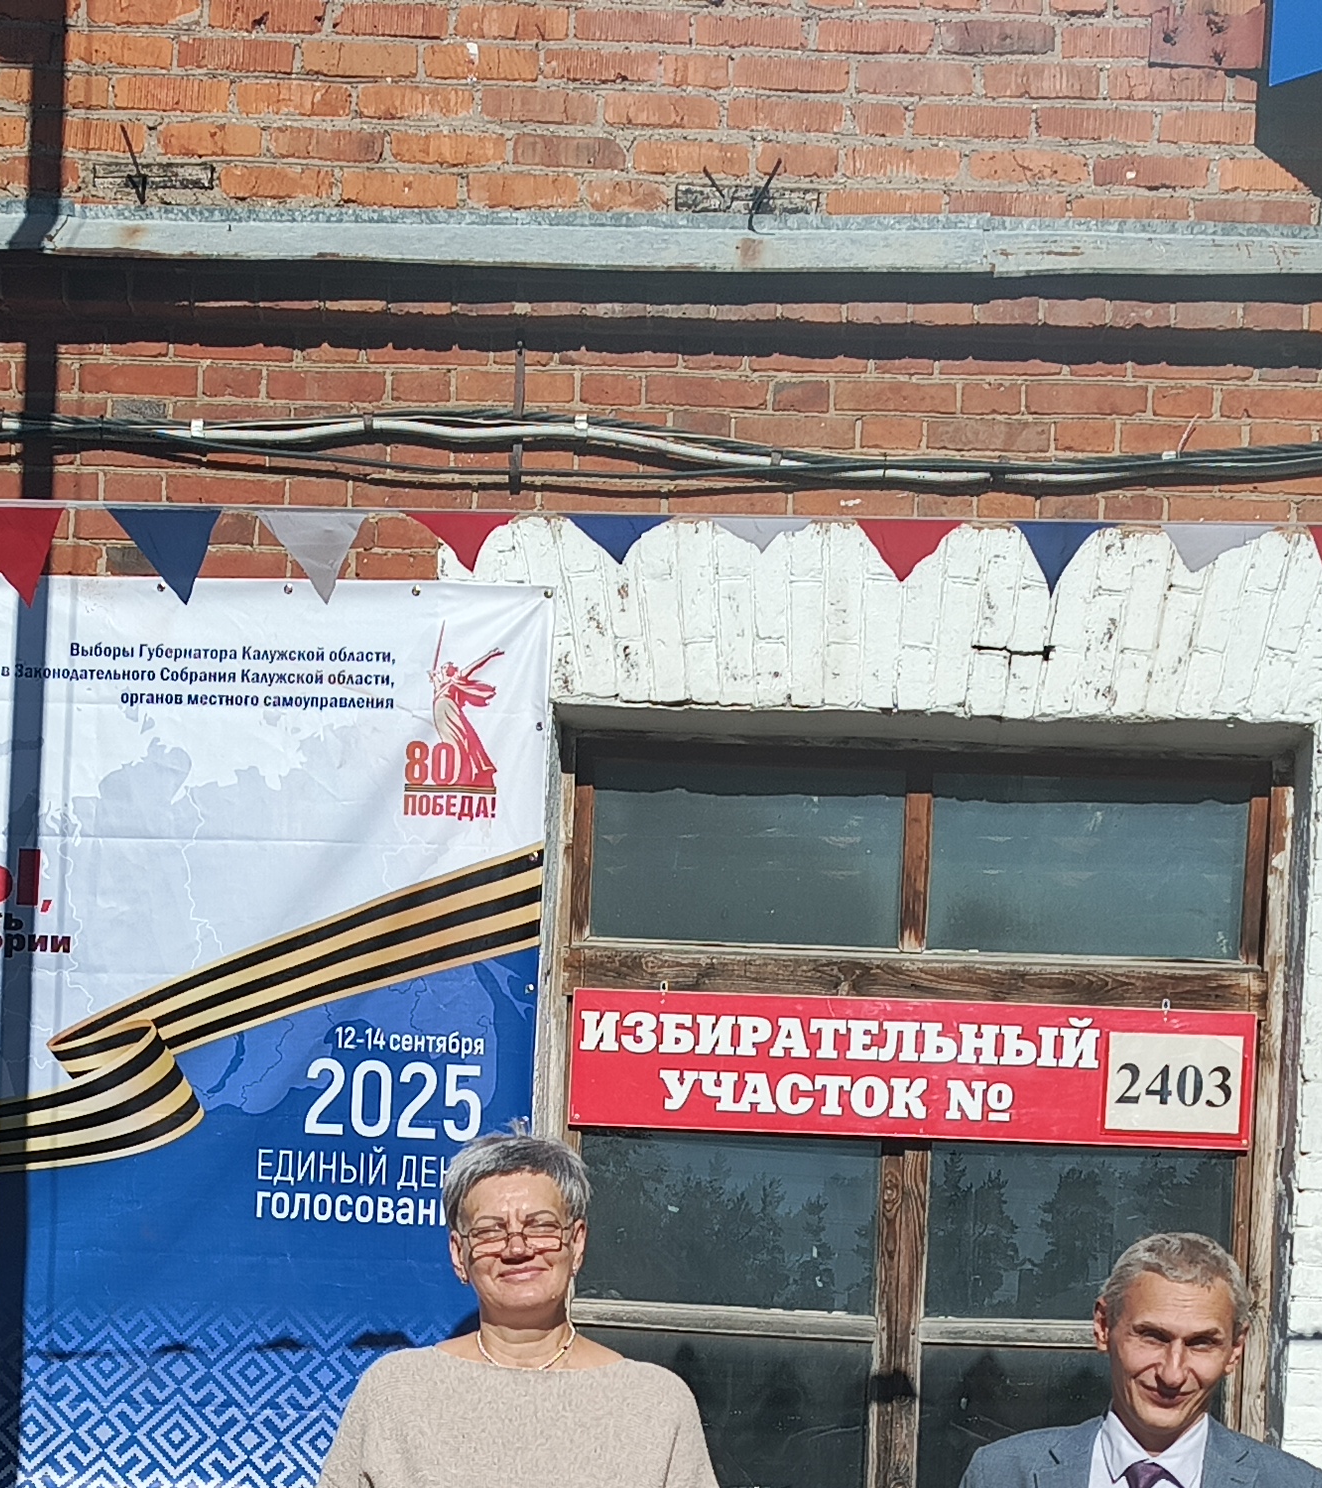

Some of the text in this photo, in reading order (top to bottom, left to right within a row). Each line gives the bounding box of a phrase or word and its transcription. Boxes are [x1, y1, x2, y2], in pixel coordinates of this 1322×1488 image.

[70, 642, 396, 665] Выборы Губернатора Калужской области,
[14, 664, 156, 682] Законодательного
[160, 667, 236, 685] Собрания
[241, 669, 324, 687] Калужской
[328, 670, 395, 688] области,
[120, 691, 395, 711] органов местного самоуправления
[405, 740, 455, 786] 80
[403, 794, 496, 821] ПОБЕДА!
[335, 1027, 485, 1056] 12-14 сентября
[579, 1008, 1100, 1069] ИЗБИРАТЕЛЬНЫЙ
[305, 1058, 482, 1142] 2025
[659, 1069, 927, 1119] УЧАСТОК
[1114, 1062, 1232, 1107] 2403
[257, 1145, 387, 1188] ЕДИНЫЙ
